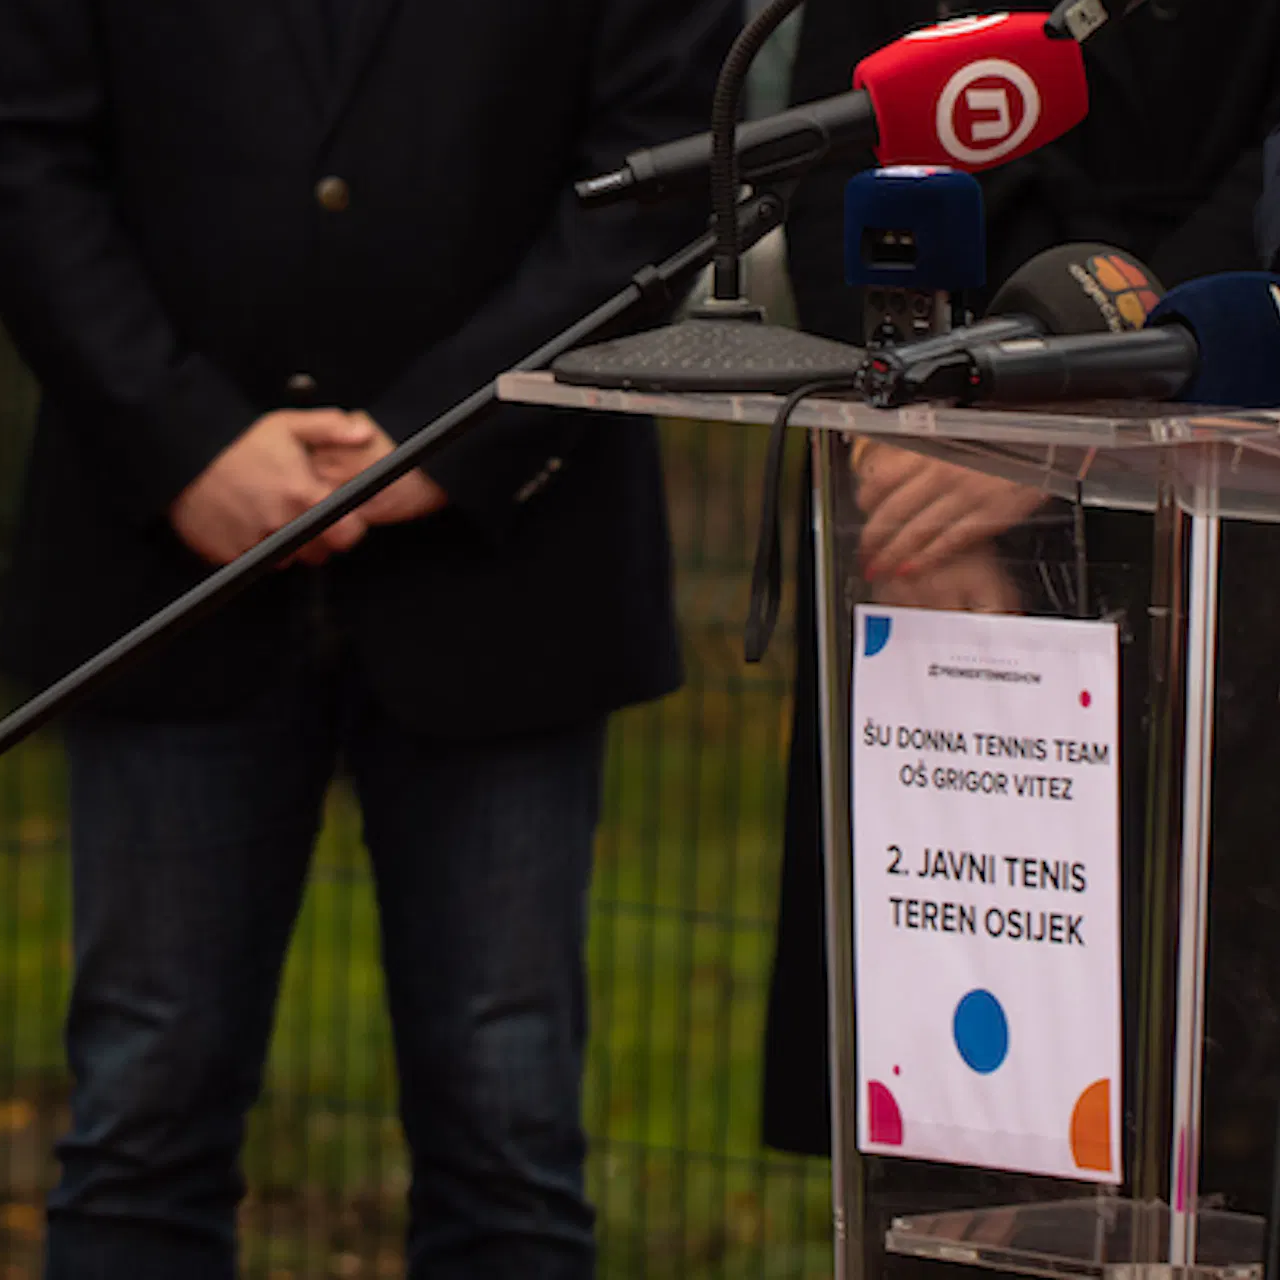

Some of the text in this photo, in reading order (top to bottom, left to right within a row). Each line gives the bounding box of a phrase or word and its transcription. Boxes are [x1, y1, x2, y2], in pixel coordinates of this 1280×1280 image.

[863, 718, 1111, 765] ŠU DONNA TENNIS TEAM
[899, 760, 1073, 801] OŠ GRIGOR VITEZ
[886, 844, 1087, 894] 2. JAVNI TENIS
[888, 896, 1085, 946] TEREN OSIJEK
